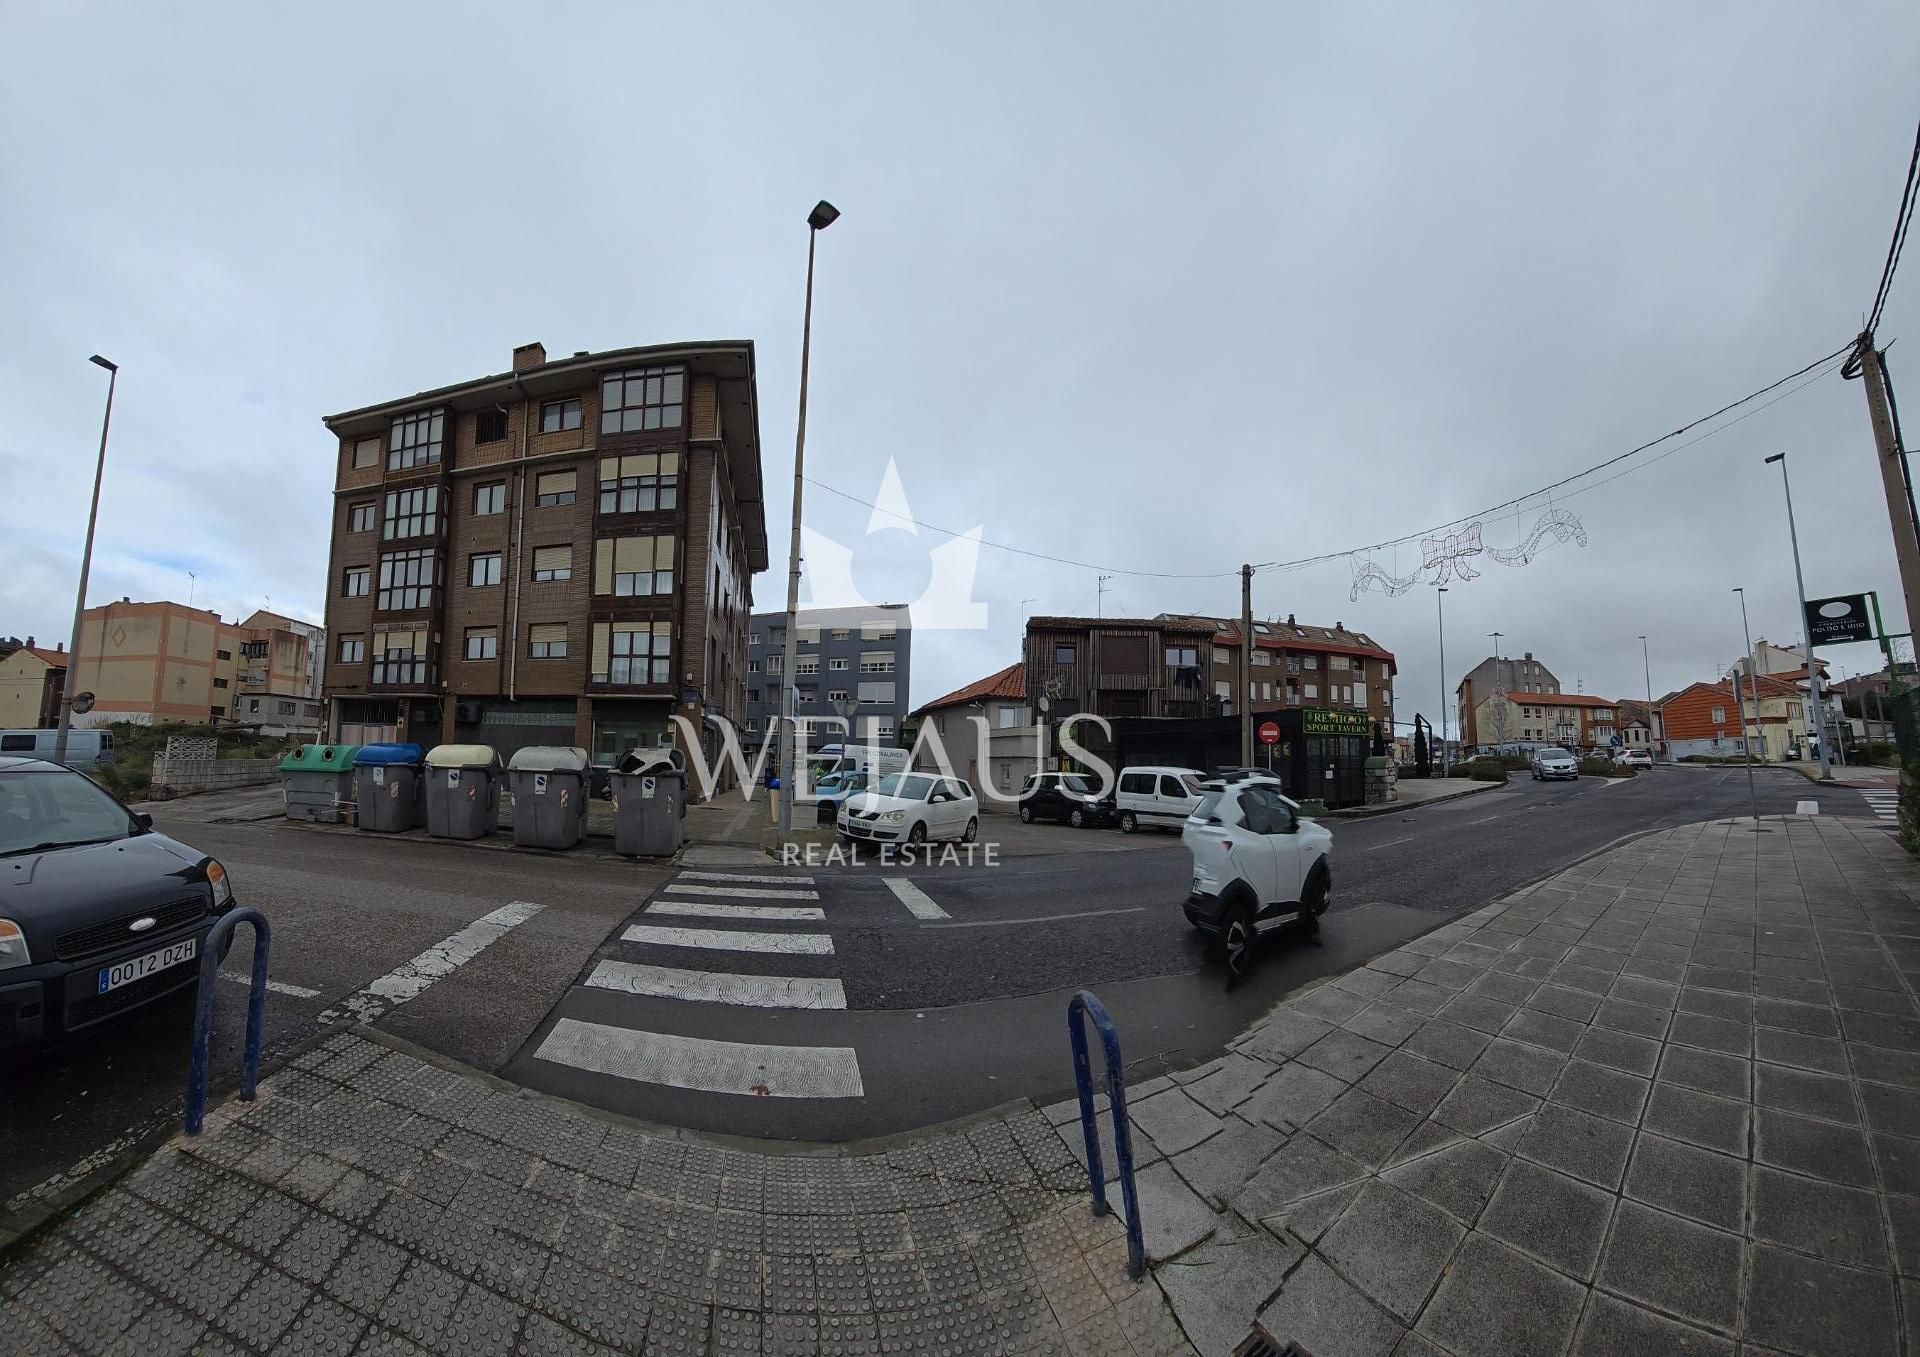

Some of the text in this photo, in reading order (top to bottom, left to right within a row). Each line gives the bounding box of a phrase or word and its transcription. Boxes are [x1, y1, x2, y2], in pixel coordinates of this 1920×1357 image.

[1314, 712, 1362, 725] REMIGO
[1306, 723, 1367, 733] SPORT TAVERN
[111, 940, 193, 986] 0012 DZH
